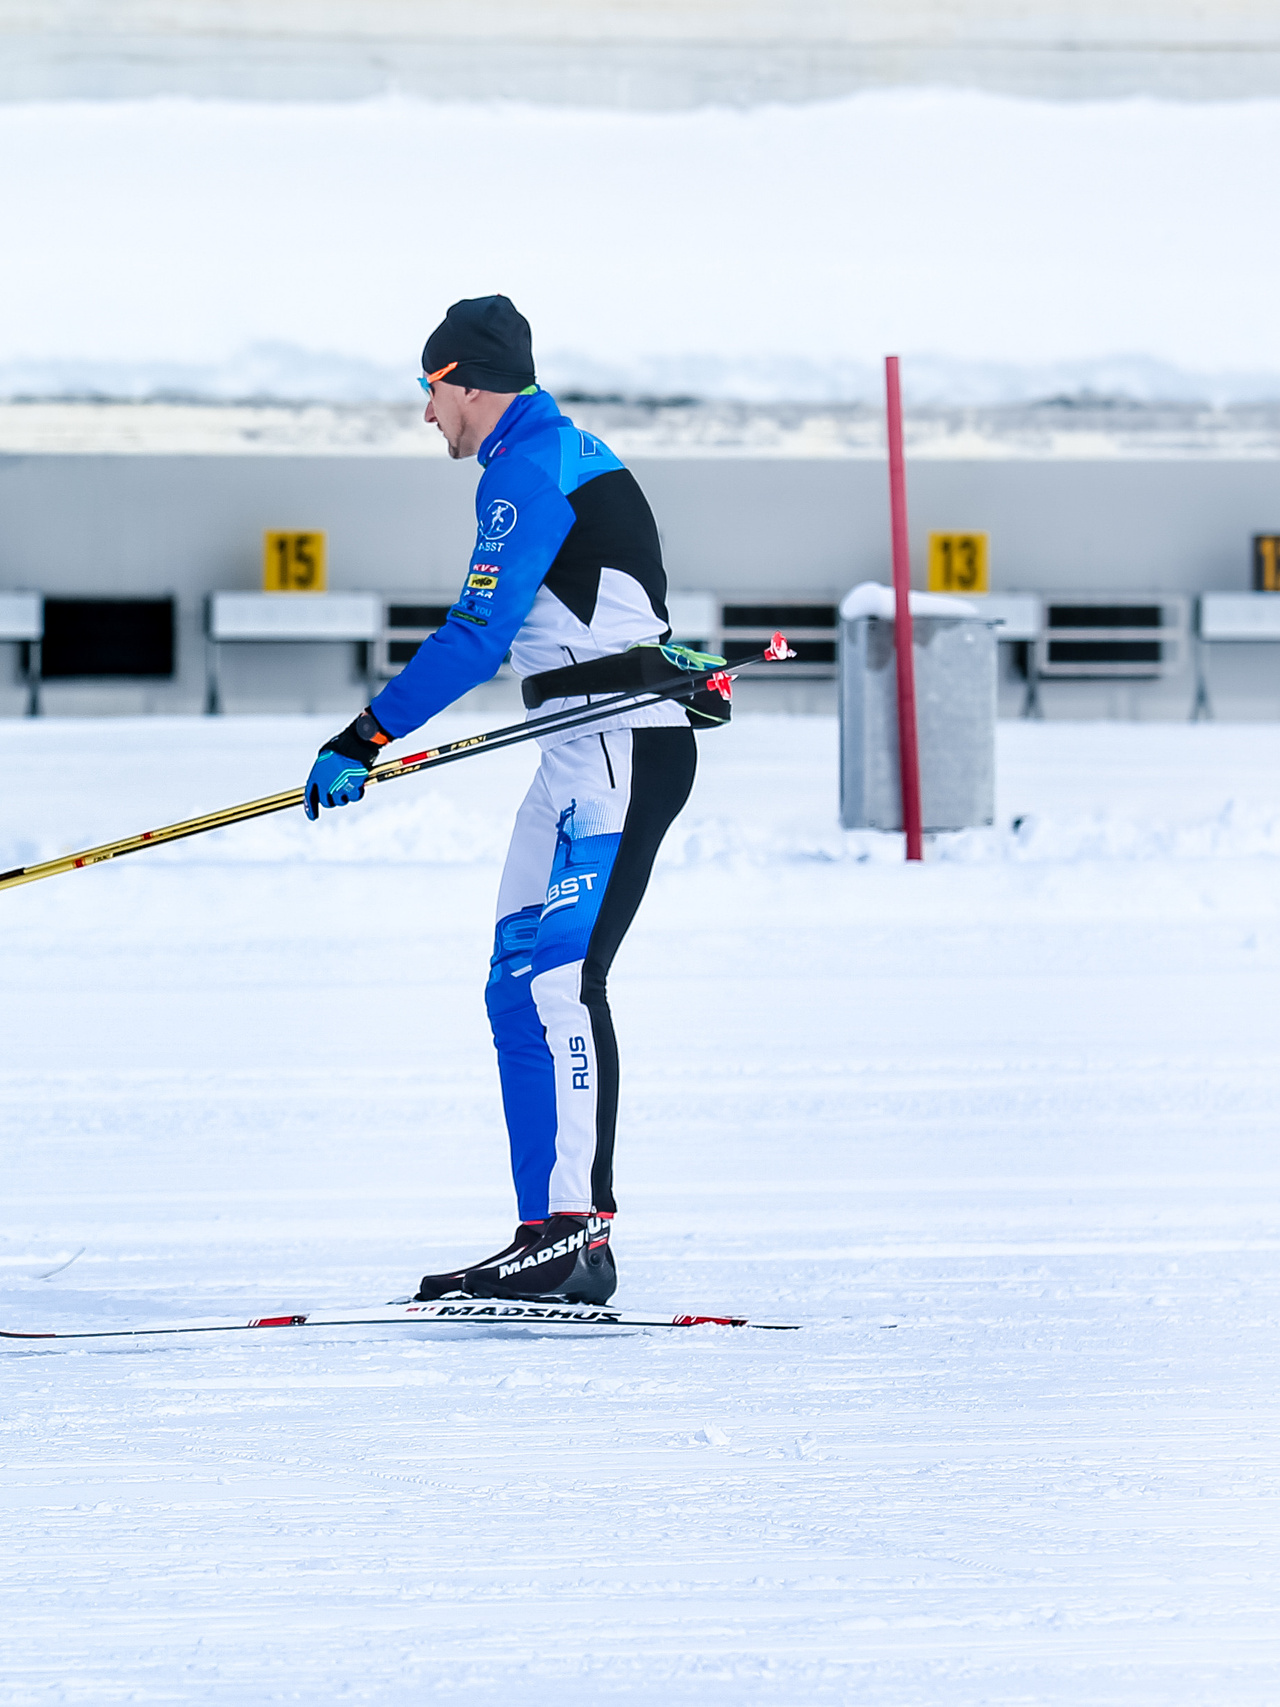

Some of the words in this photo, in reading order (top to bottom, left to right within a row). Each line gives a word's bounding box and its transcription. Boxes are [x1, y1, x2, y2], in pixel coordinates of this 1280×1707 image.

[276, 534, 315, 589] 15
[941, 537, 977, 590] 13
[1261, 537, 1280, 590] 1
[569, 1036, 589, 1090] RUS
[436, 1306, 621, 1322] MADSHUS
